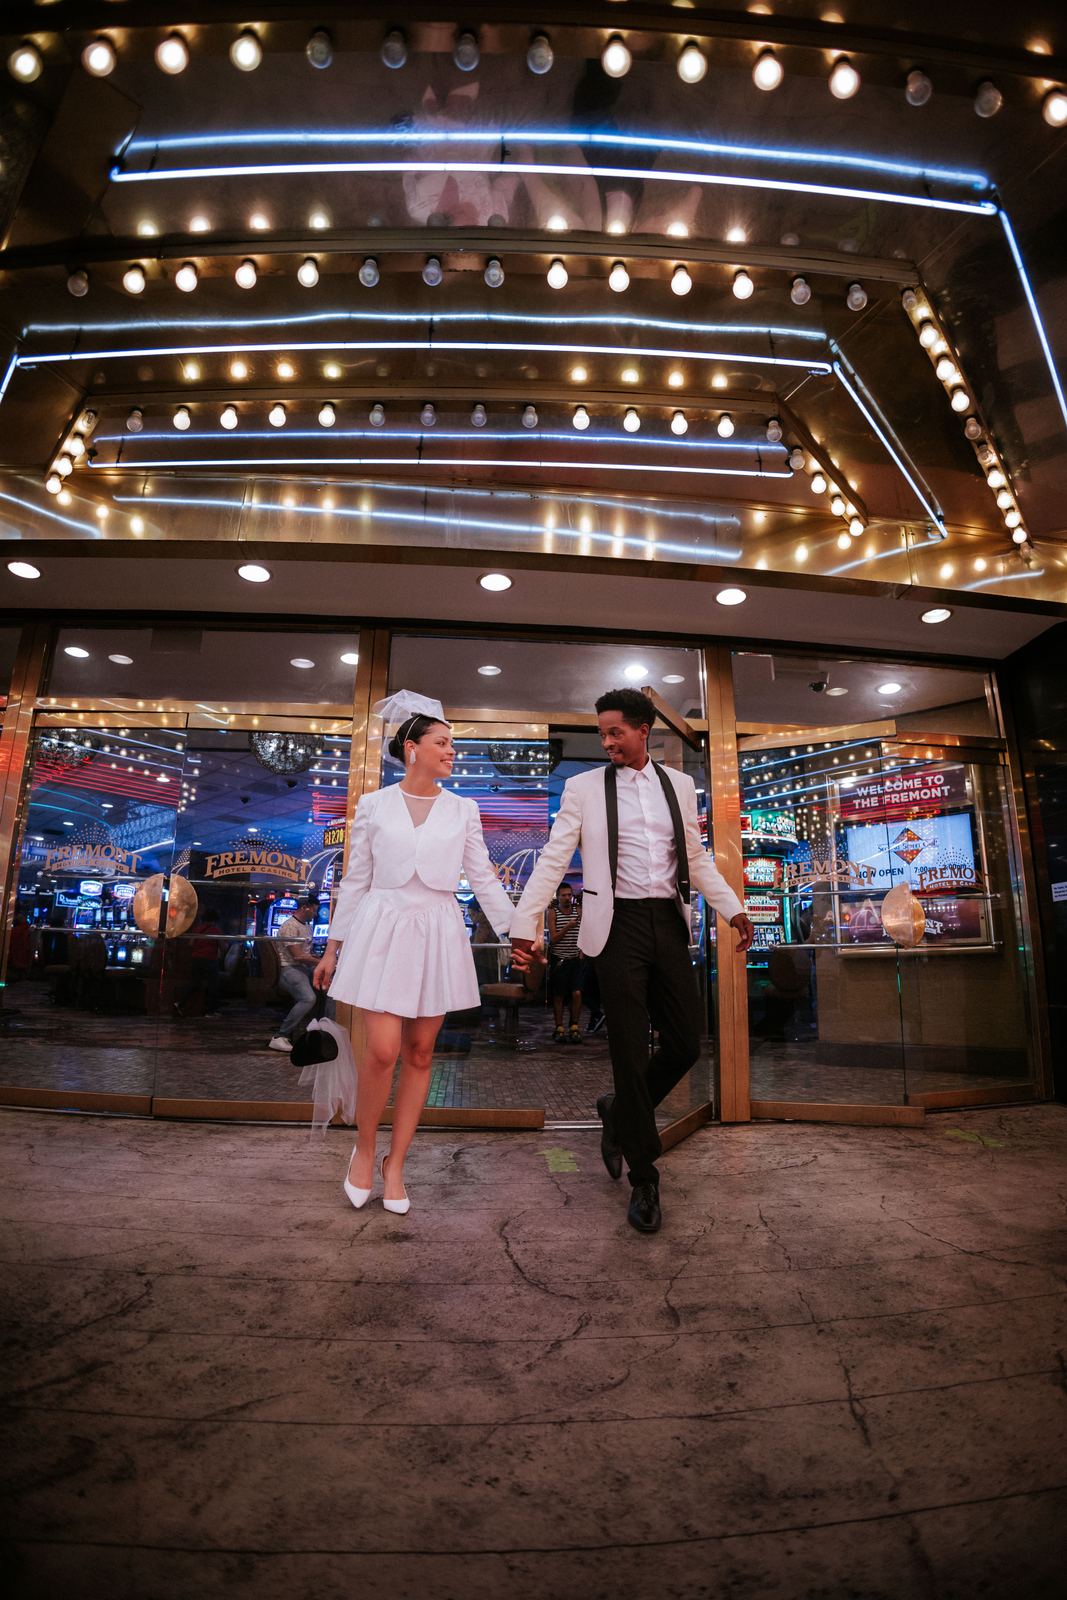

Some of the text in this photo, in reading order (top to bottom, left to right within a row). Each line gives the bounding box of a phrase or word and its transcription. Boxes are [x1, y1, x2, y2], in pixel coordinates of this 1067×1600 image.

[853, 785, 951, 810] THE FREMONT
[856, 774, 945, 797] WELCOME TO
[43, 844, 143, 874] FREMONT
[203, 850, 312, 882] FREMONT
[218, 867, 246, 876] HOTEL
[260, 866, 294, 878] CASINO
[772, 859, 877, 889] FREMONT
[879, 867, 904, 878] OPEN
